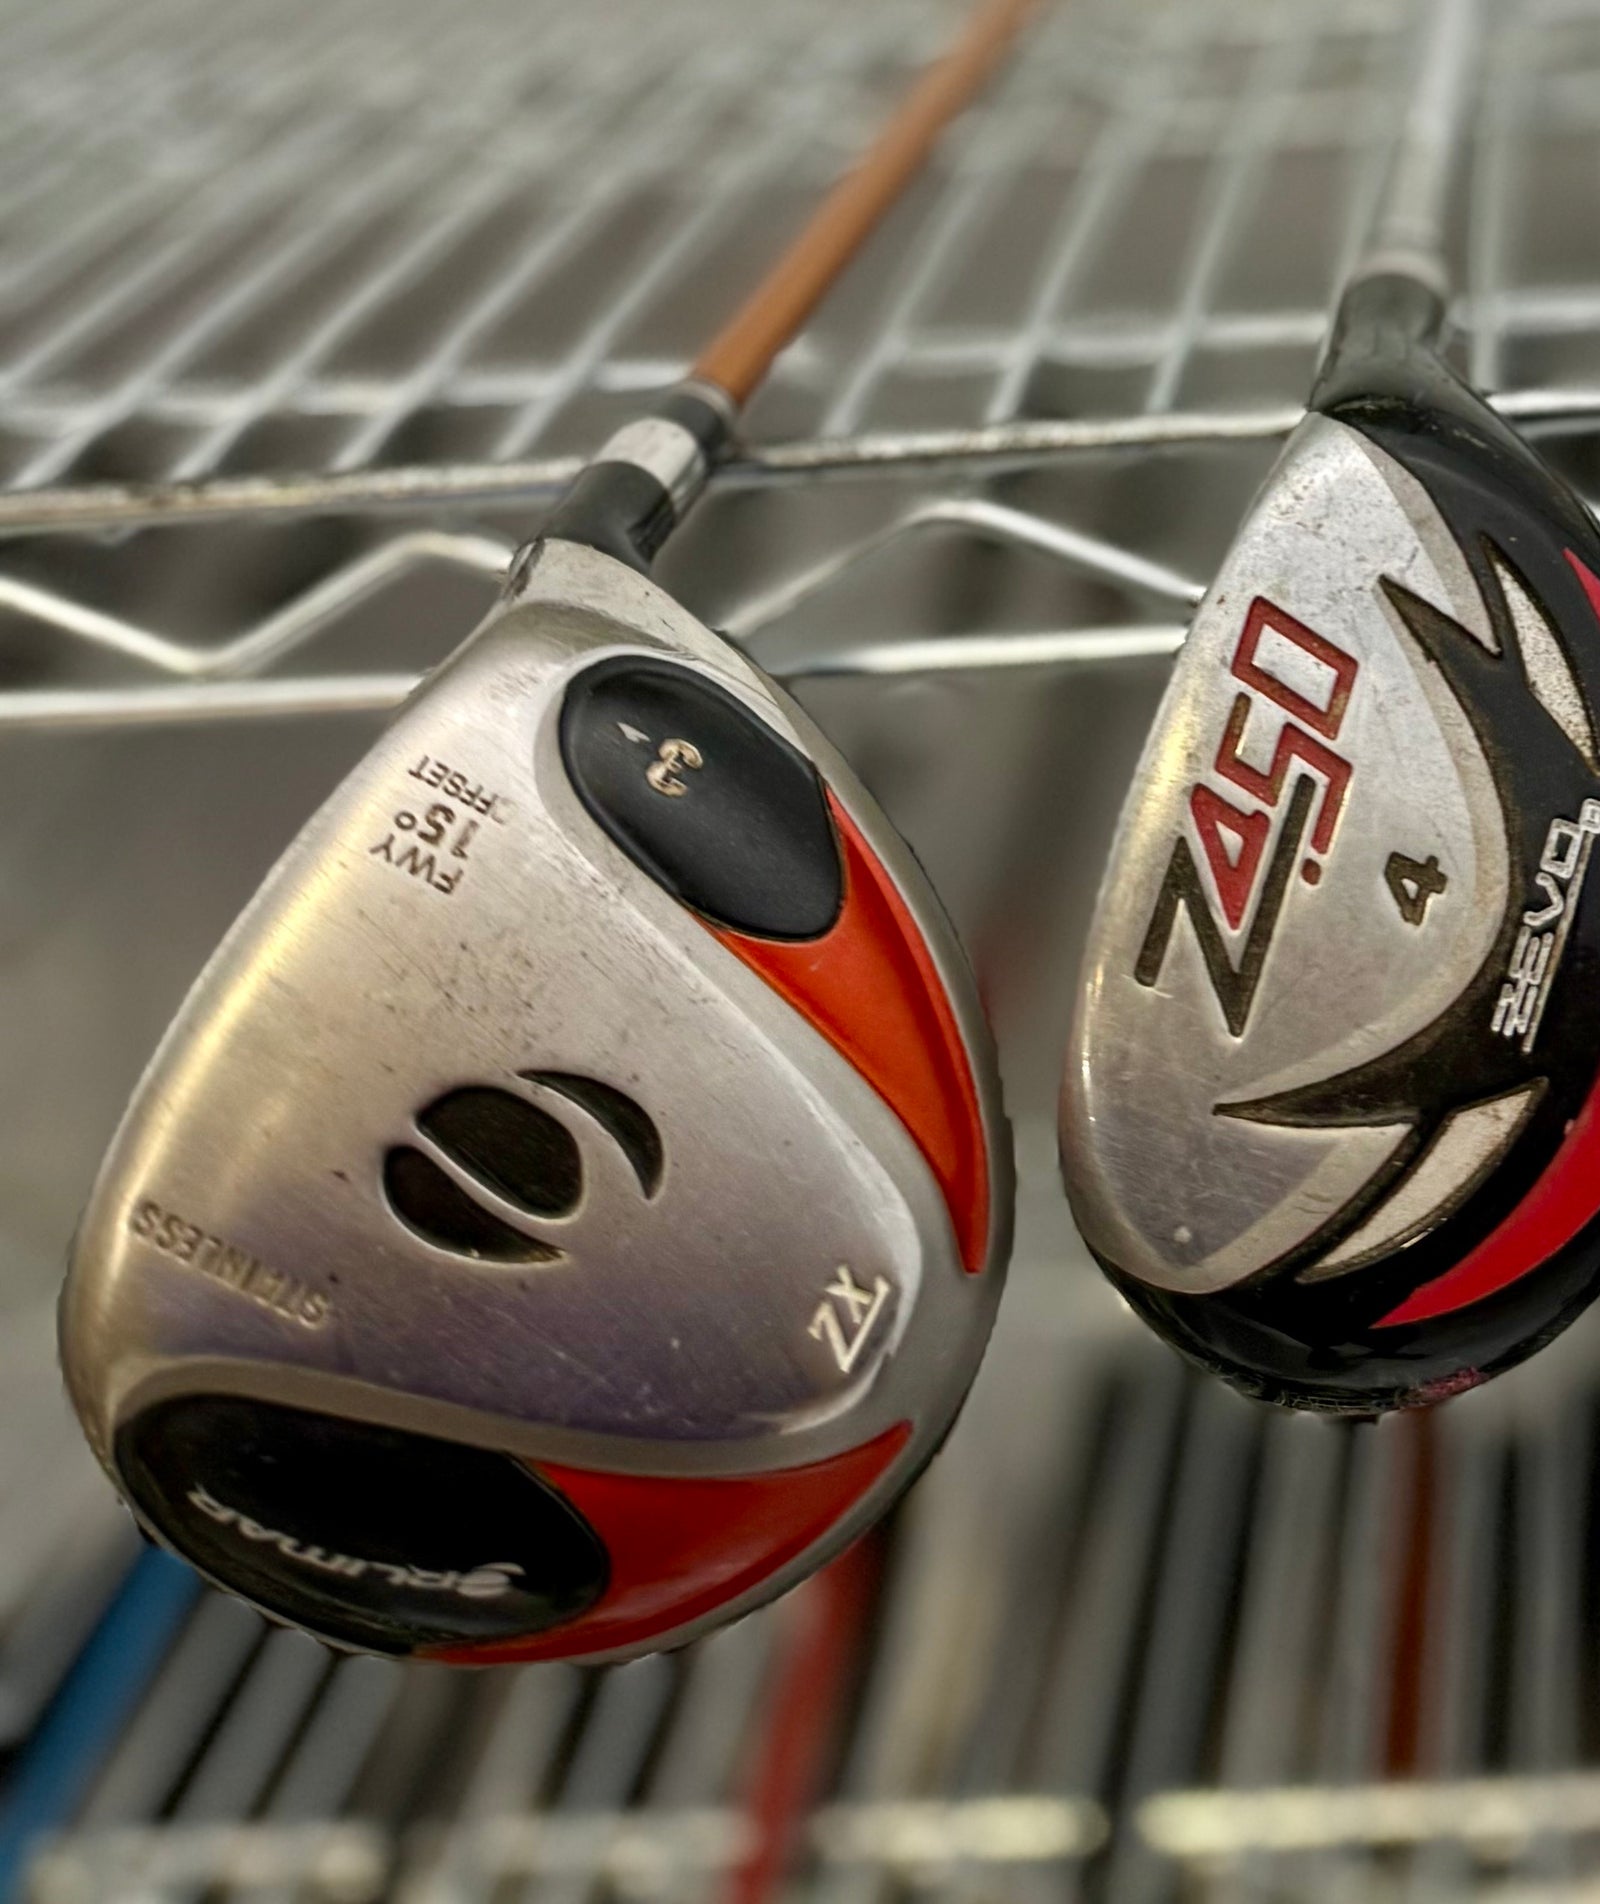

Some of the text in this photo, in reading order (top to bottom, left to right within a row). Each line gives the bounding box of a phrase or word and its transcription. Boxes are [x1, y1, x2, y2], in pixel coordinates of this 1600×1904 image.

[646, 738, 704, 798] 3
[1134, 596, 1360, 1039] Z450
[369, 832, 464, 895] FWY
[1384, 852, 1448, 927] 4
[131, 1199, 333, 1330] STAINLESS
[808, 1264, 890, 1373] ZX
[187, 1486, 527, 1599] ORLIMAR
